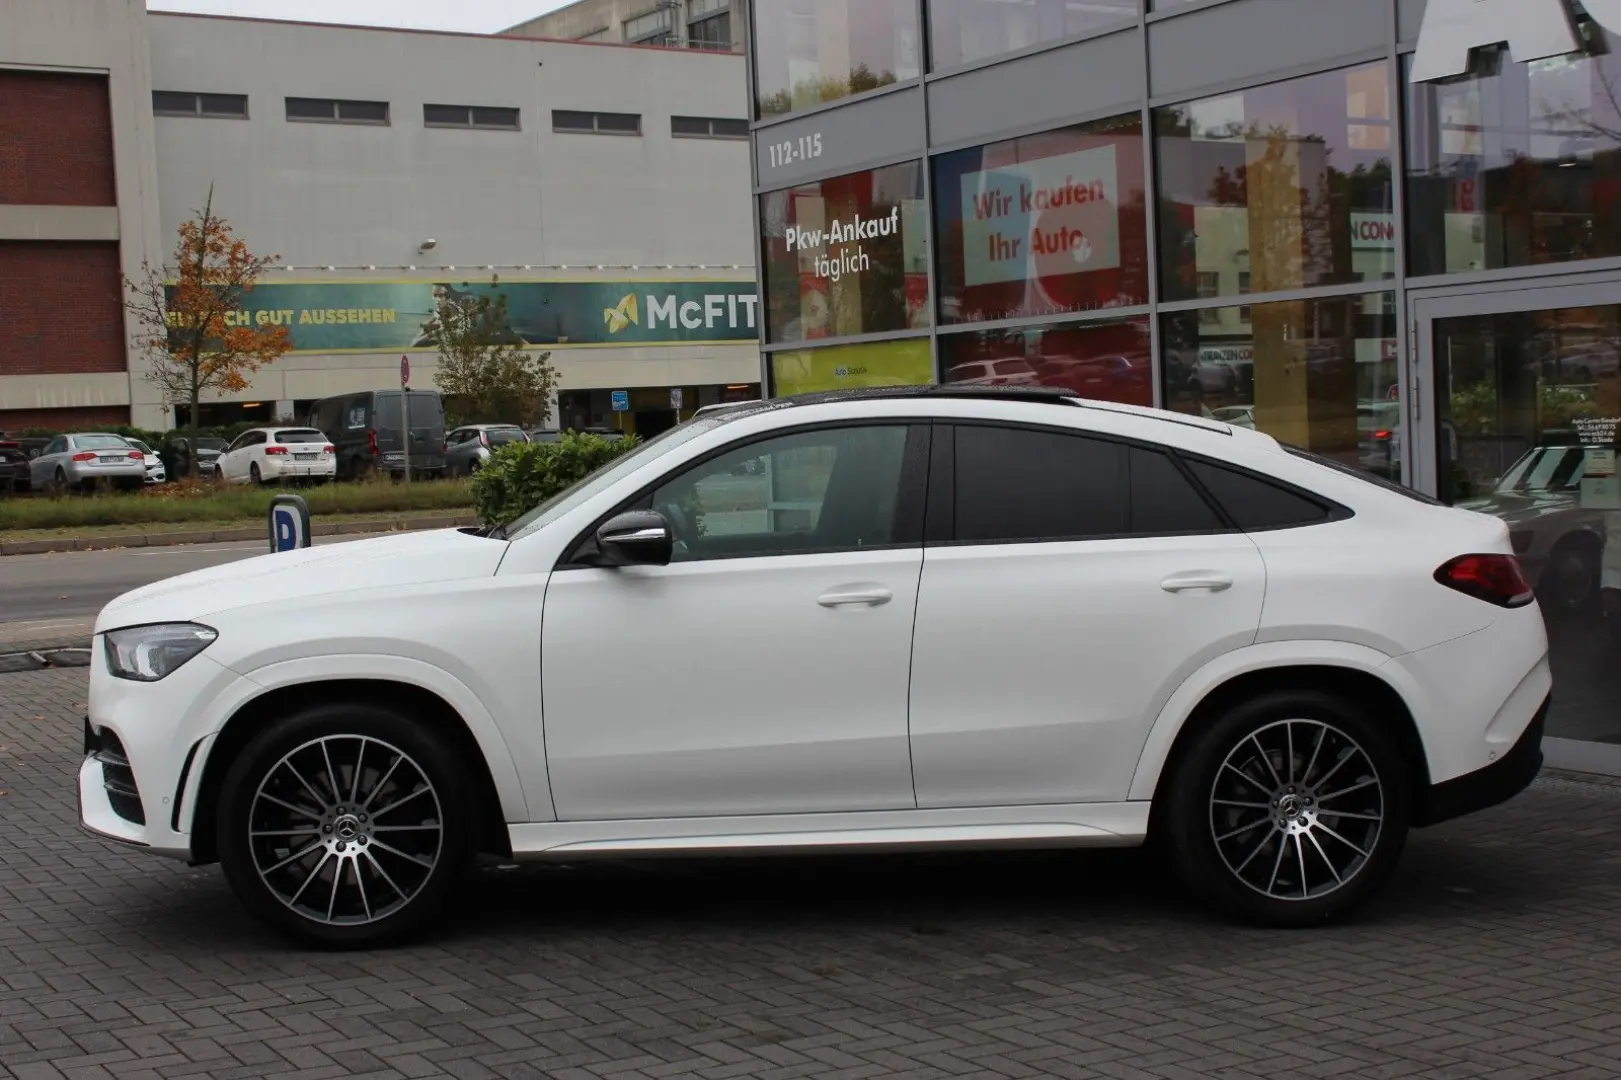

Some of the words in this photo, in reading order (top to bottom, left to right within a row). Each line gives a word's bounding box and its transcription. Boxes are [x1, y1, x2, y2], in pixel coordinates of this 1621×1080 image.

[769, 132, 822, 168] 112-115
[973, 186, 1013, 220] Wir
[1019, 175, 1105, 214] kaufen
[785, 205, 899, 252] Pkw-Ankauf
[988, 232, 1021, 261] Ihr
[813, 245, 870, 282] täglich
[255, 309, 295, 326] GUT
[299, 308, 396, 325] AUSSEHEN
